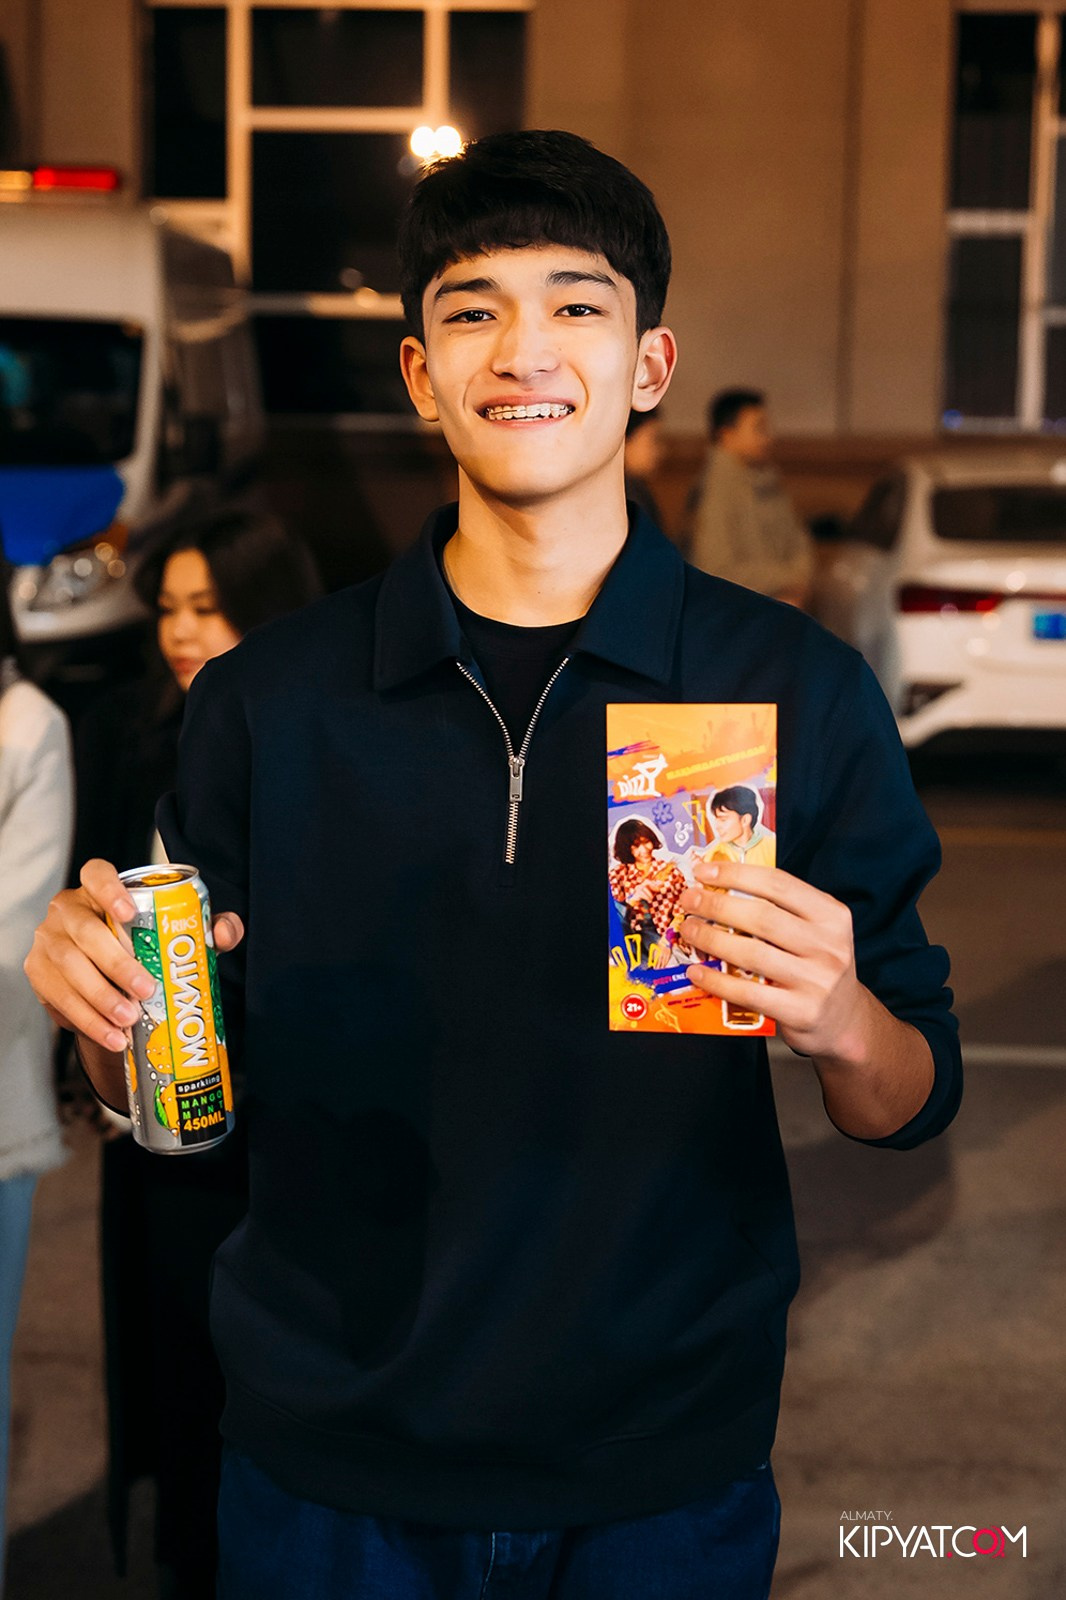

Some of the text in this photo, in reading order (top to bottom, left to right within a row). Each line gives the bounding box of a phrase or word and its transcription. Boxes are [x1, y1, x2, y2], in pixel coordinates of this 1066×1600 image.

[171, 914, 198, 934] RIKS
[167, 934, 209, 1068] МОХИТО
[626, 1002, 642, 1013] 21+
[177, 1074, 221, 1093] sparkling
[181, 1089, 223, 1110] MANGO
[182, 1100, 224, 1120] MINT
[183, 1111, 225, 1131] 450ML
